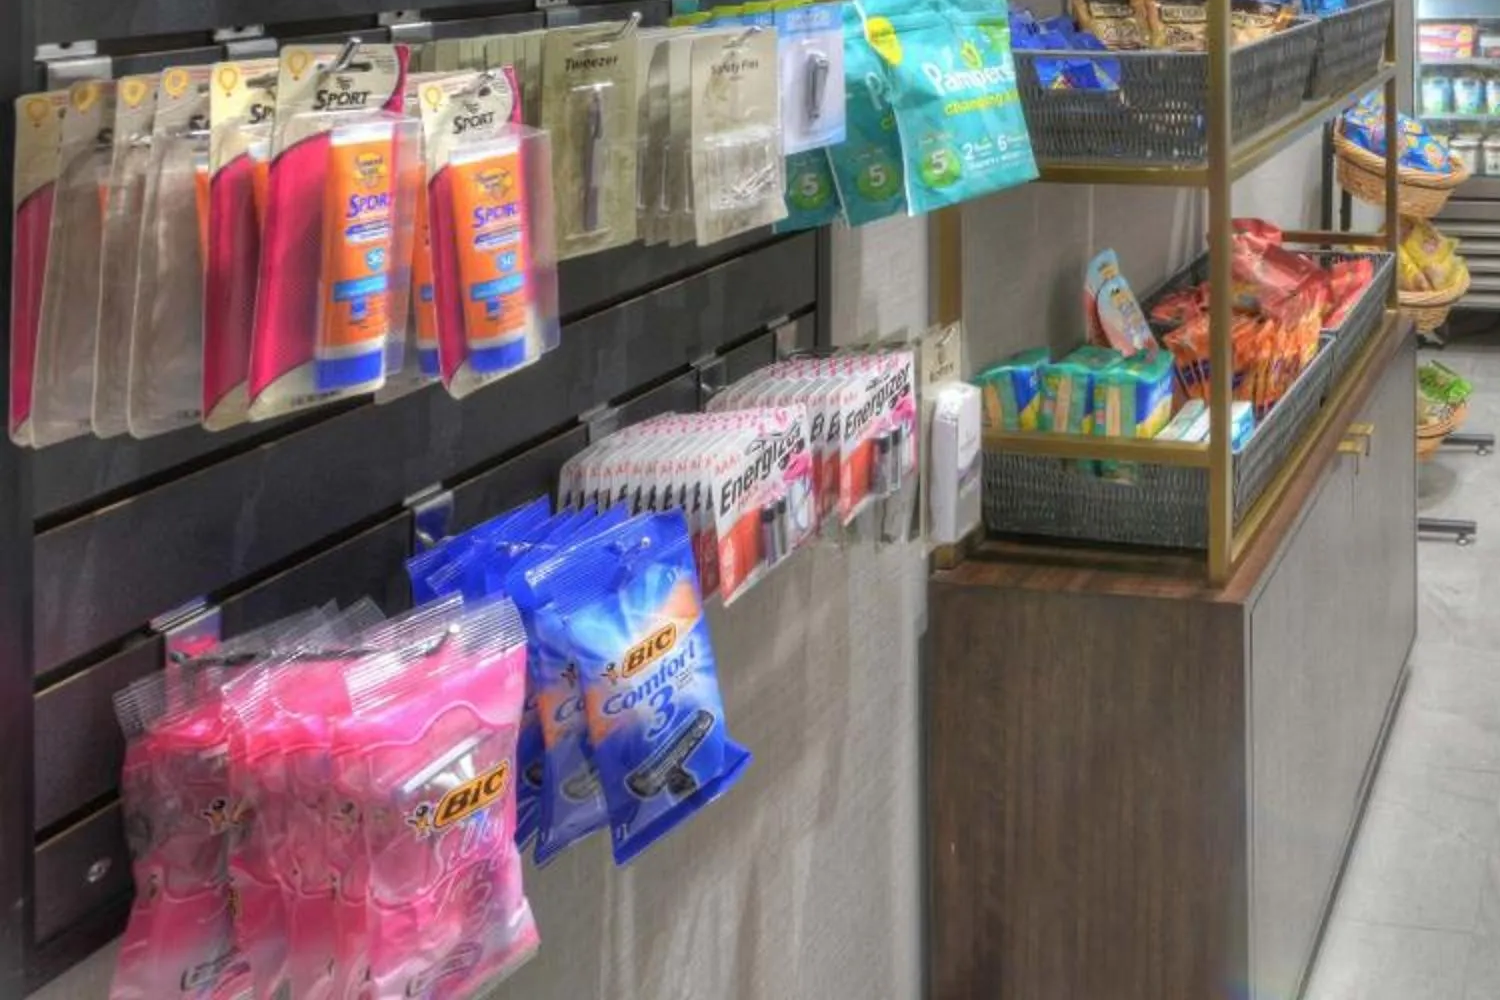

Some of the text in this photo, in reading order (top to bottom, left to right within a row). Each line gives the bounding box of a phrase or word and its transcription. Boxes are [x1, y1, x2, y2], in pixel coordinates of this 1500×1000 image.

[564, 55, 619, 73] Tweezer
[312, 89, 370, 112] SPORT
[452, 110, 495, 135] SPORT
[931, 149, 949, 175] 5
[801, 172, 819, 196] 5
[868, 163, 886, 188] 5
[603, 638, 695, 715] Comfort
[646, 684, 675, 739] 3
